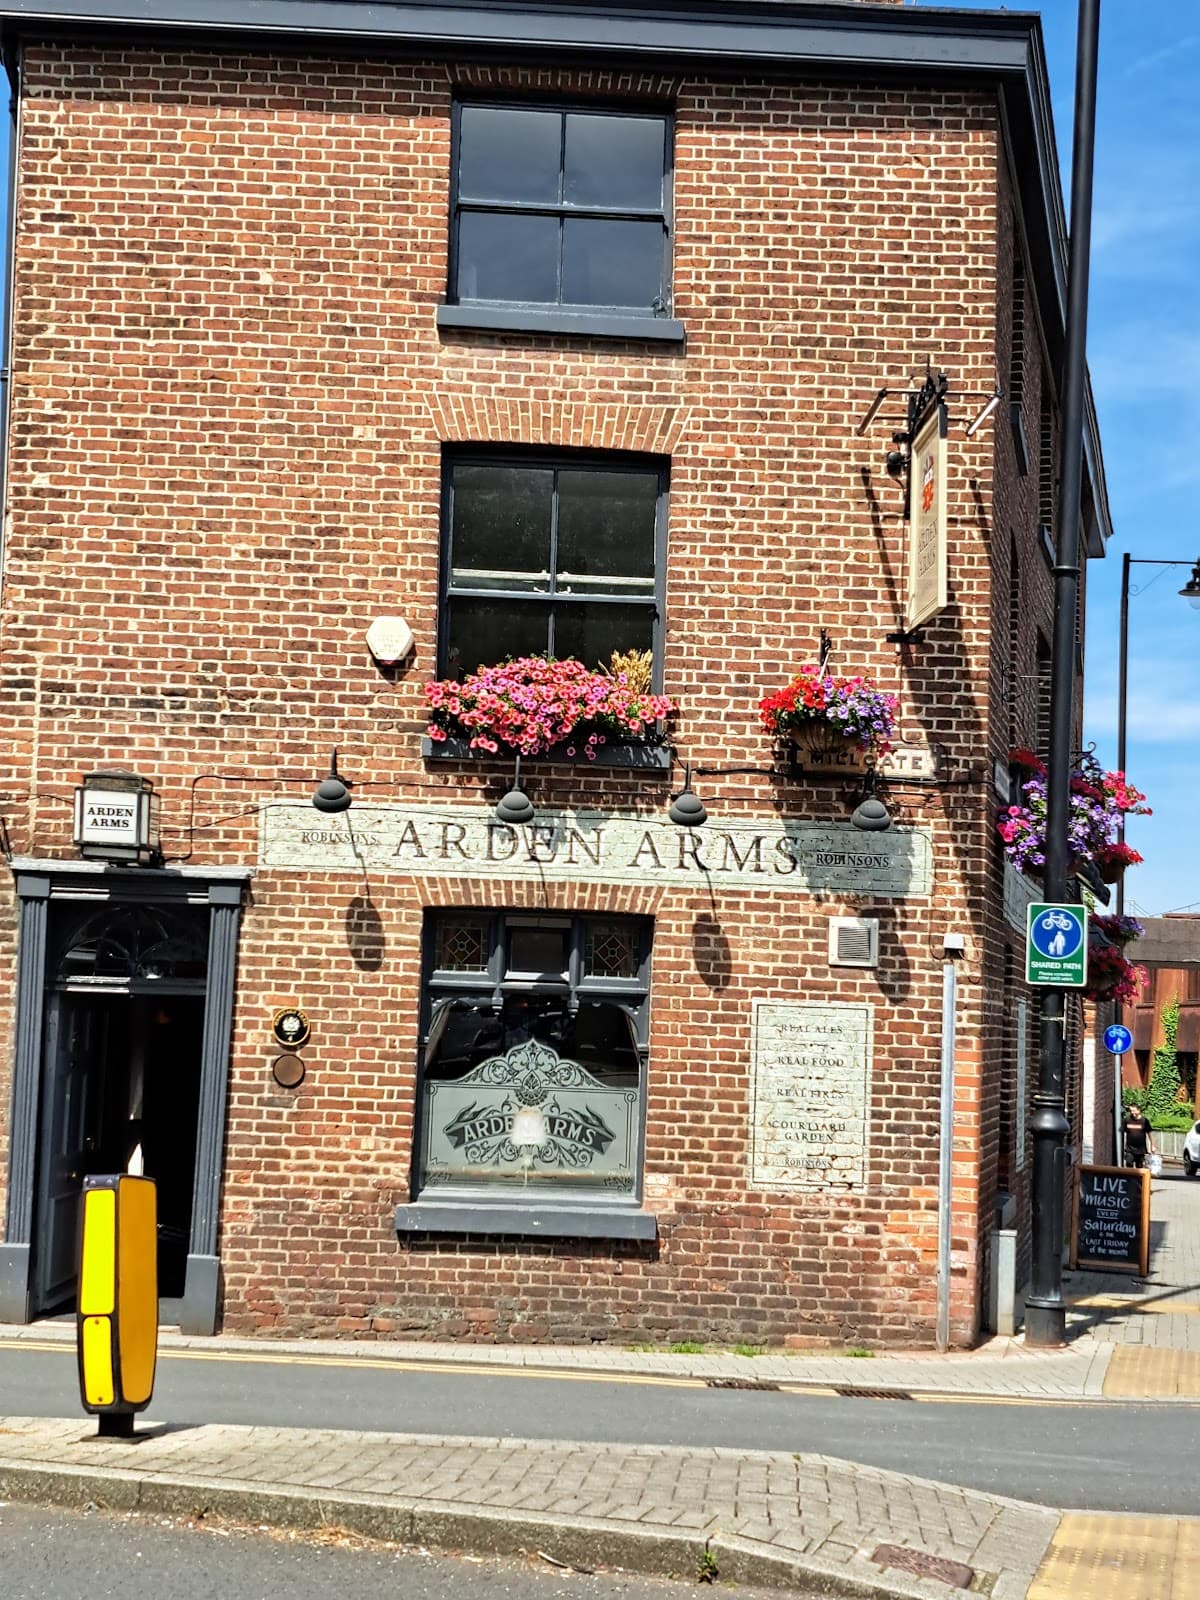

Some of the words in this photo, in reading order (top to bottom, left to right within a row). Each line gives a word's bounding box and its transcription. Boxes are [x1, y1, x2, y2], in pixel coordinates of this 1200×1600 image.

[88, 807, 134, 817] ARDEN
[91, 818, 129, 828] ARMS
[391, 819, 603, 866] ARDEN
[627, 831, 799, 875] ARMS
[816, 851, 890, 868] ROBINSONS
[1031, 961, 1061, 969] SHARED
[1062, 962, 1081, 970] PATH
[781, 1024, 810, 1034] REAL
[815, 1026, 843, 1034] ALES
[778, 1056, 808, 1065] REAL
[812, 1058, 844, 1067] FOOD
[777, 1088, 806, 1098] REAL
[810, 1090, 844, 1100] FIRES
[464, 1115, 515, 1142] ARDE
[772, 1120, 845, 1132] COURTYARD
[785, 1132, 834, 1142] GARDEN
[1094, 1176, 1127, 1193] LIVE
[1085, 1219, 1136, 1238] Saturday
